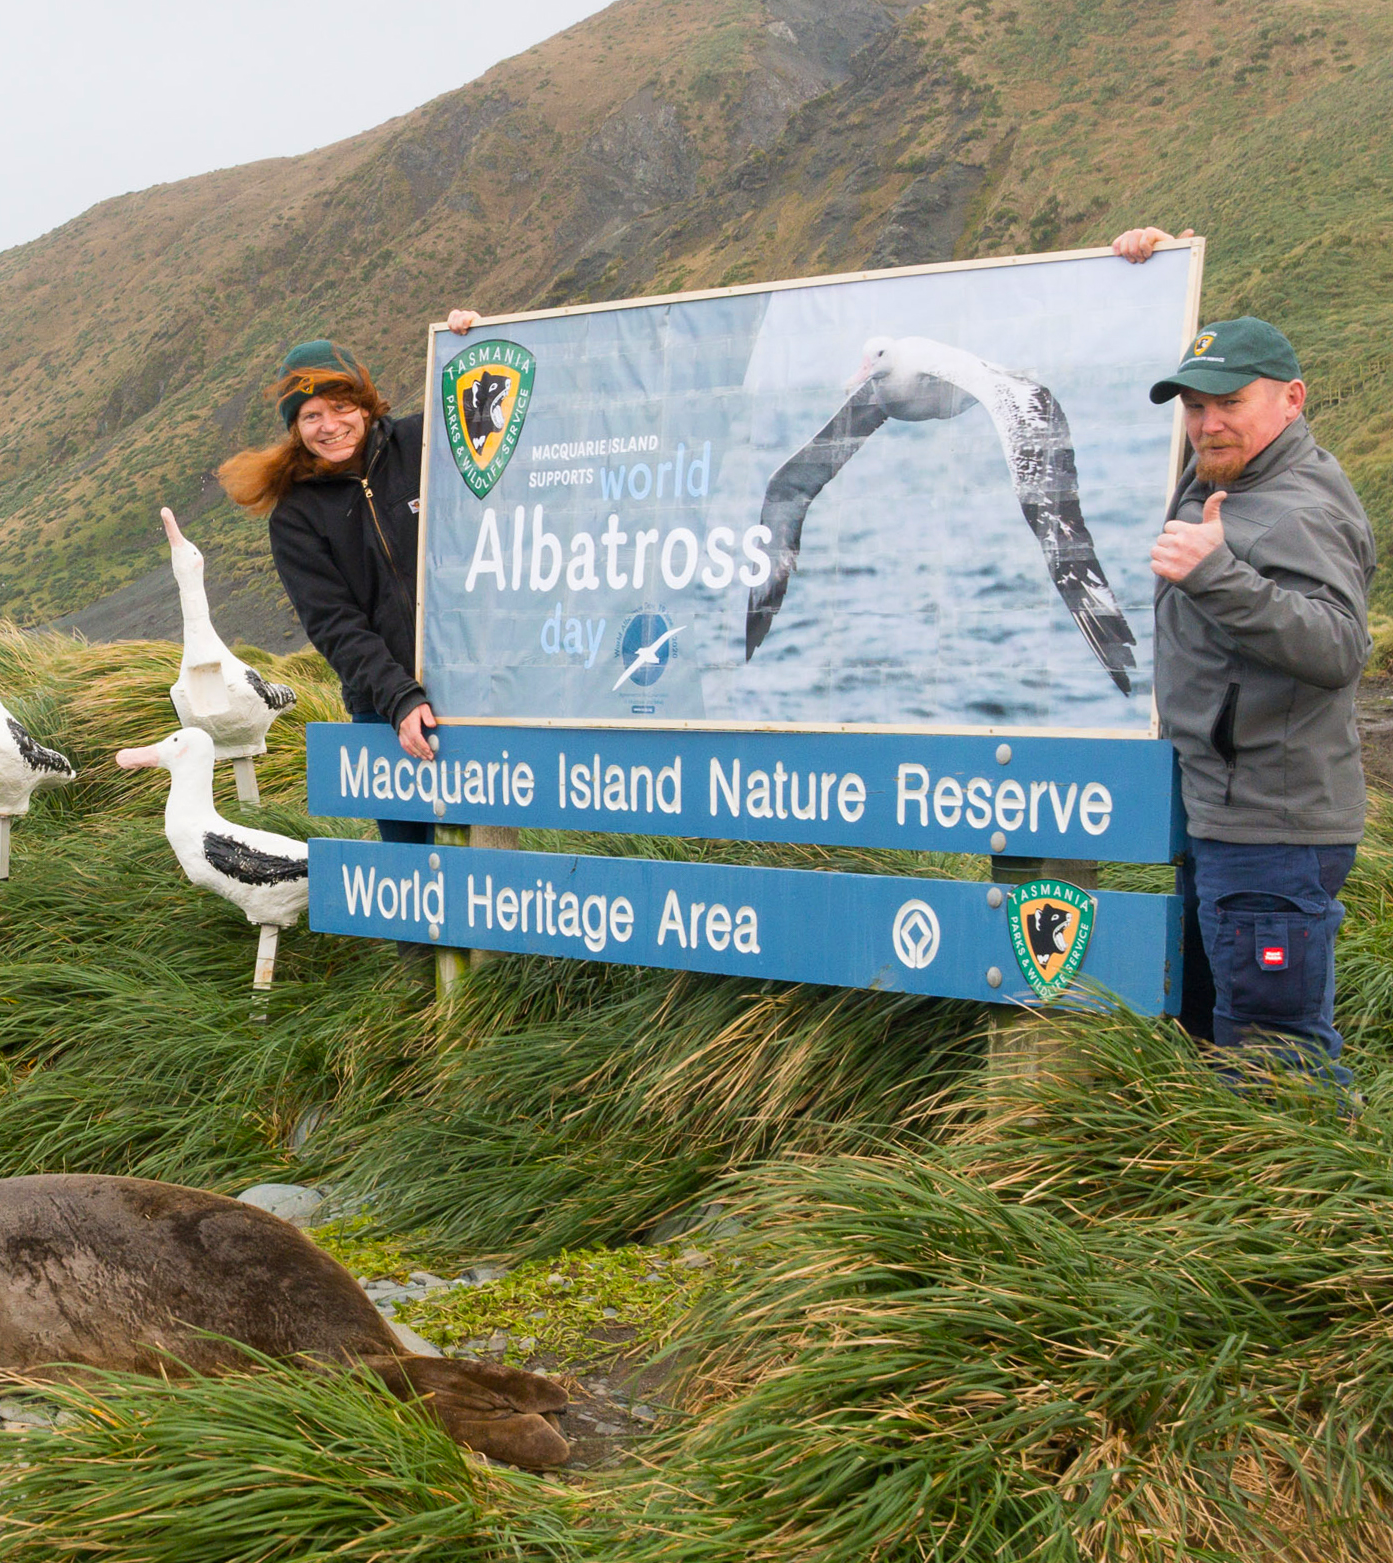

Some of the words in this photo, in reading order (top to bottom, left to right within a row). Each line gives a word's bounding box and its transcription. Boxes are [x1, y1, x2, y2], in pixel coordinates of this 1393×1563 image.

[447, 346, 530, 380] TASMANIA
[446, 395, 461, 443] PARKS
[456, 446, 465, 457] &
[462, 456, 503, 489] WILDLIFE
[502, 388, 529, 455] SERVICE
[528, 468, 594, 488] SUPPORTS
[600, 440, 712, 501] world
[532, 439, 606, 461] MACQUARIE
[608, 435, 659, 454] ISLAND
[464, 504, 773, 593] Albatross
[540, 602, 606, 669] day
[339, 745, 535, 816] Macquarie
[558, 752, 683, 815] Island
[709, 756, 867, 823] Nature
[896, 762, 1114, 836] Reserve
[341, 863, 445, 925] World
[467, 873, 635, 953] Heritage
[657, 888, 762, 955] Area
[1011, 884, 1089, 912] TASMANIA
[1011, 916, 1026, 956] PARKS
[1022, 958, 1030, 968] &
[1065, 922, 1089, 974] SERVICE
